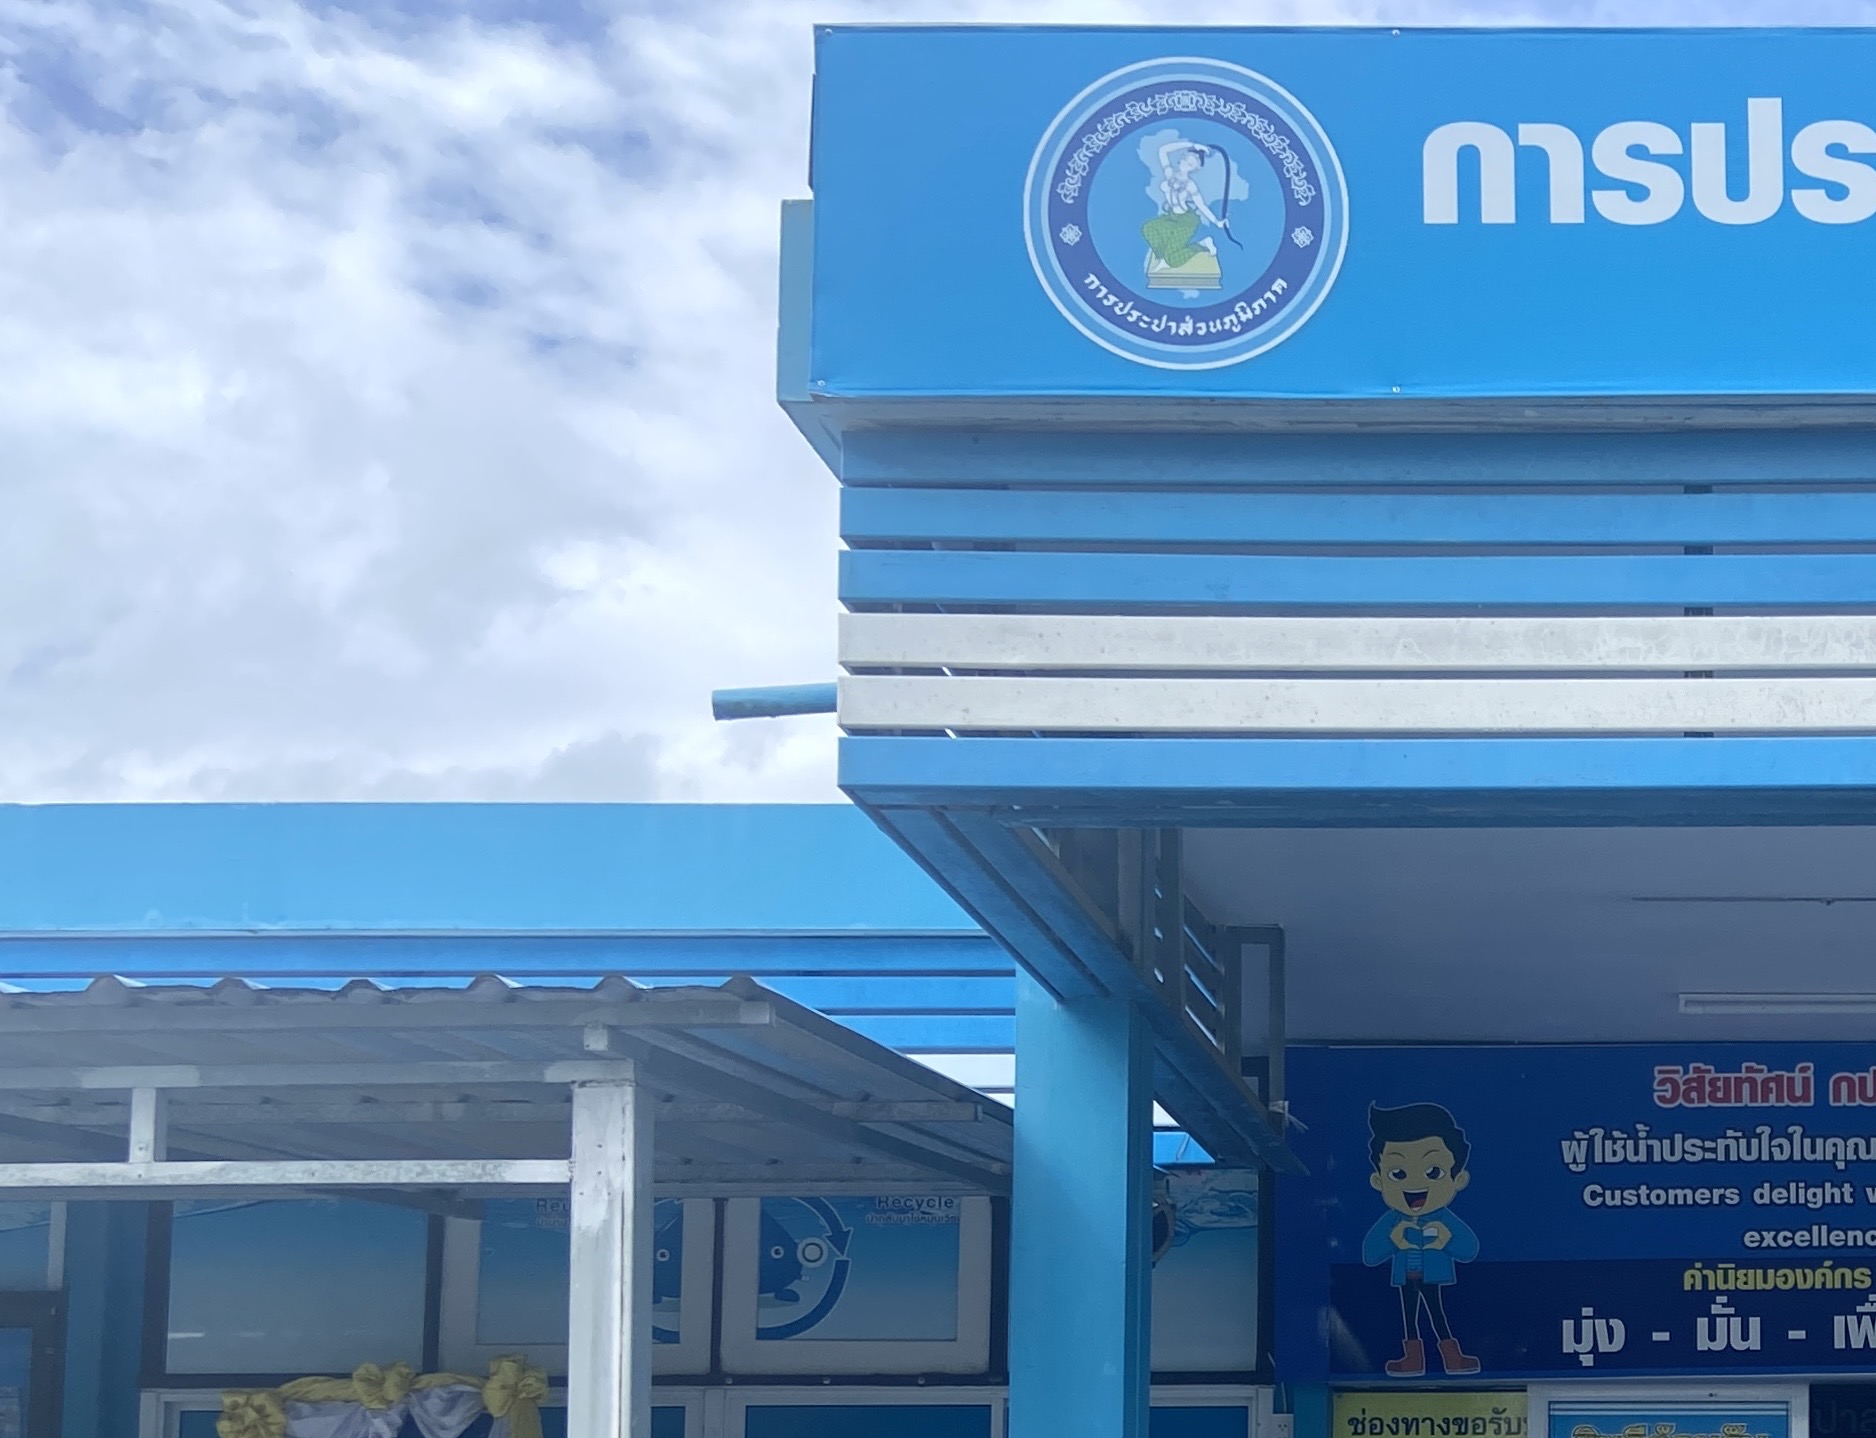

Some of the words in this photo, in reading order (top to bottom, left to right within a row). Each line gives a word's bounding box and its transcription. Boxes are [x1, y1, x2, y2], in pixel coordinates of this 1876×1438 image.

[1083, 271, 1290, 339] การประปาส่วนภูมิภาค
[1654, 1063, 1815, 1107] วิสัยทัศน์
[1583, 1184, 1740, 1207] Customers
[1753, 1182, 1854, 1210] delight
[1683, 1261, 1873, 1291] ค่านิยมองค์กร
[1562, 1306, 1626, 1366] มุ่ง
[1696, 1296, 1762, 1351] มั่น
